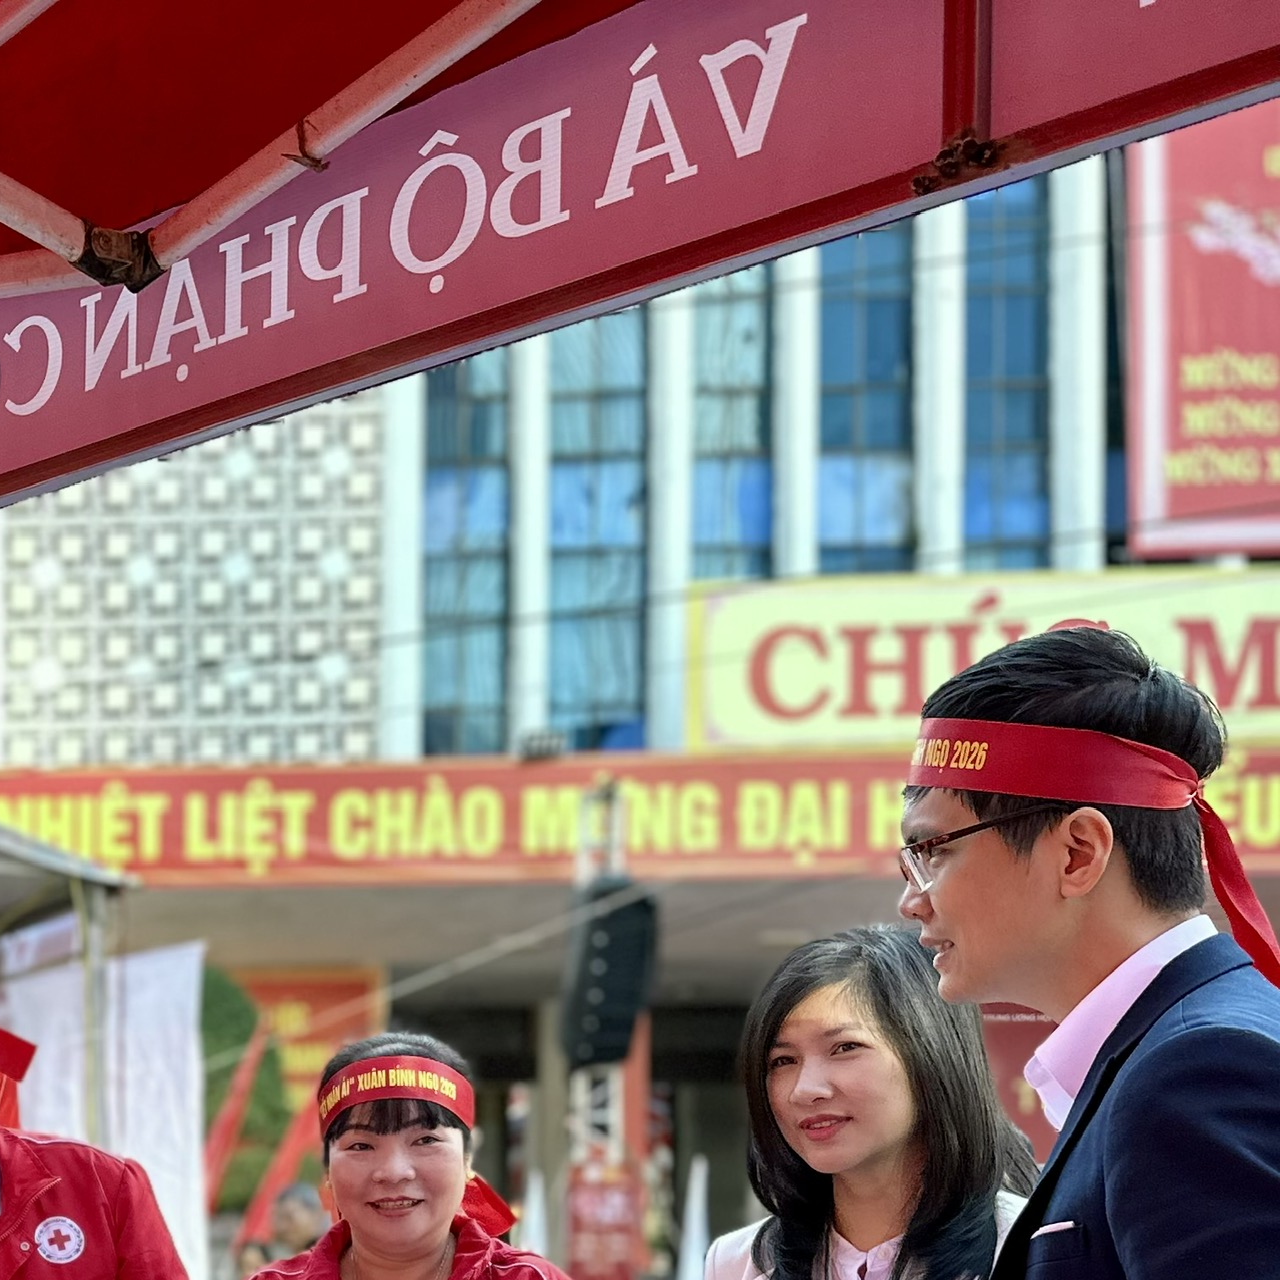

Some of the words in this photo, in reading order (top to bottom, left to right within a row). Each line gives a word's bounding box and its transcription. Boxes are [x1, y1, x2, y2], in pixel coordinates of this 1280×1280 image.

[748, 592, 1110, 720] CHÚ
[926, 739, 949, 774] NGỌ
[950, 740, 988, 771] 2026
[186, 779, 314, 876] LIỆT
[330, 774, 504, 858] CHÀO
[738, 780, 848, 866] ĐẠI
[357, 1068, 387, 1092] XUÂN
[389, 1064, 416, 1087] BÍNH
[418, 1070, 439, 1095] NGỌ
[440, 1077, 457, 1101] 2026
